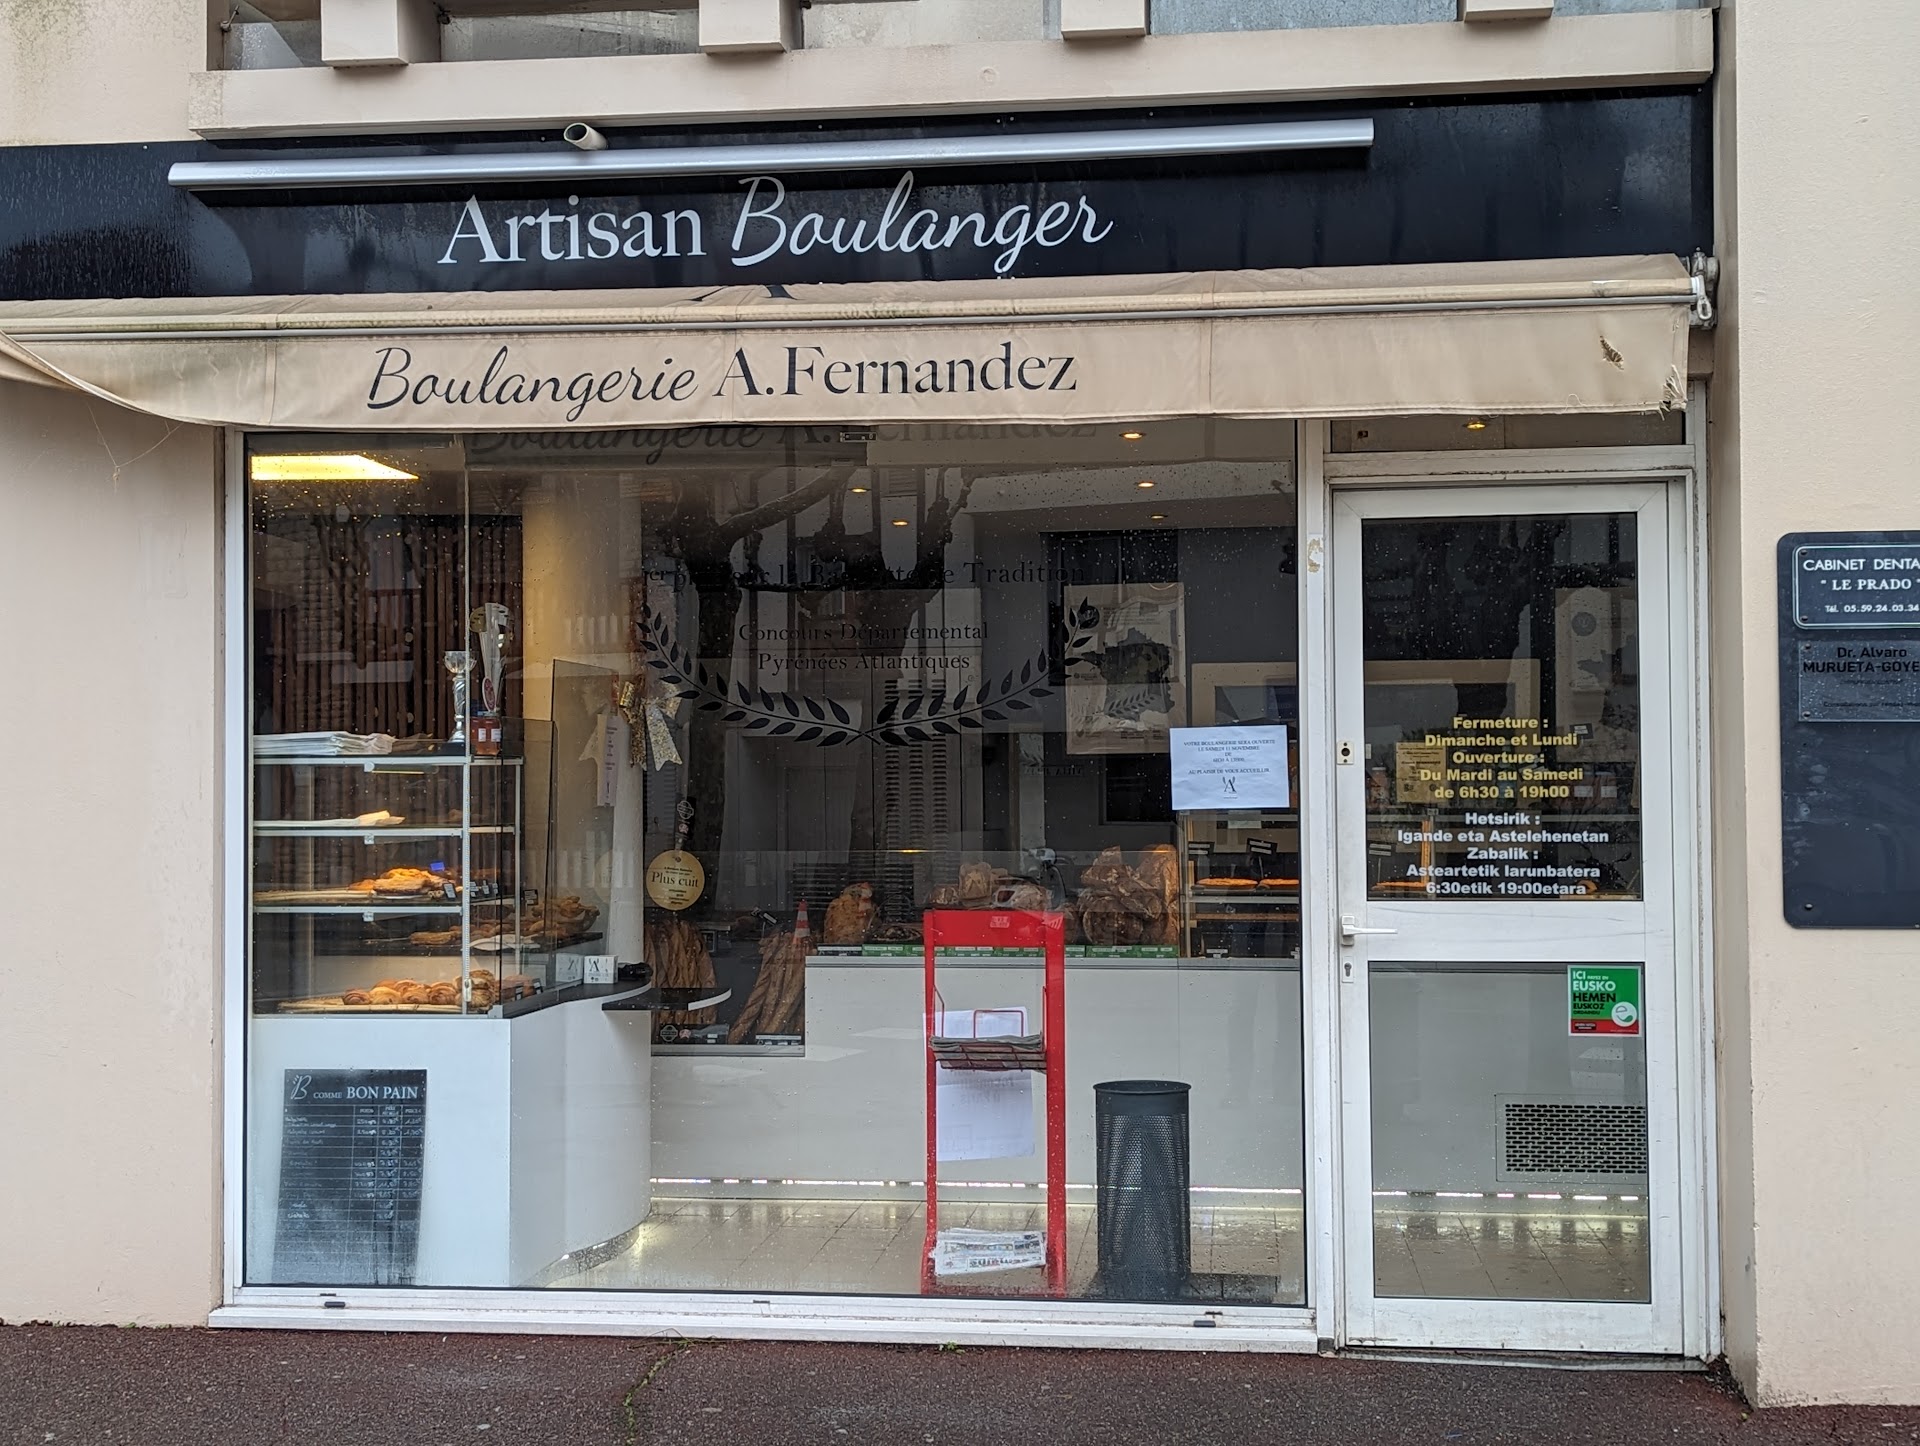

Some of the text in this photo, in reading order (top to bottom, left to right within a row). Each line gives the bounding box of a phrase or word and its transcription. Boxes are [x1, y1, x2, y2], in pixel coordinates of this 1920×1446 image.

[437, 170, 1114, 272] Artisan Boulanger
[367, 342, 1077, 422] Boulangerie A.Fernandez
[962, 559, 1085, 584] Tradition
[1803, 558, 1866, 571] CABINET
[1857, 578, 1912, 590] PRADO
[738, 621, 988, 646] Concours Départemental
[1837, 647, 1908, 659] Dr. Alvaro
[757, 651, 971, 677] Pyrénées Atlantiques
[1453, 716, 1539, 730] Fermeture
[1425, 732, 1578, 747] Dimanche et Lundi
[1453, 751, 1534, 764] Ouverture
[1420, 767, 1583, 782] Du Mardi au Samedi
[1434, 785, 1570, 799] de 6h30 à 19h00
[1465, 812, 1530, 825] Hetsirik
[1398, 829, 1609, 844] Igande eta Astelehenetan
[1467, 847, 1529, 860] Zabalik
[1406, 864, 1500, 878] Asteartetik
[651, 871, 675, 885] Plus
[678, 875, 699, 888] cuit
[1426, 881, 1587, 895] 6:30etik 19:00etara
[1573, 970, 1586, 980] ICI
[1573, 980, 1616, 992] EUSKO
[1573, 992, 1617, 1003] HEMEN
[1573, 1002, 1605, 1010] EUSKOZ
[313, 1091, 342, 1099] COMME
[346, 1086, 379, 1099] BON
[383, 1086, 418, 1099] PAIN
